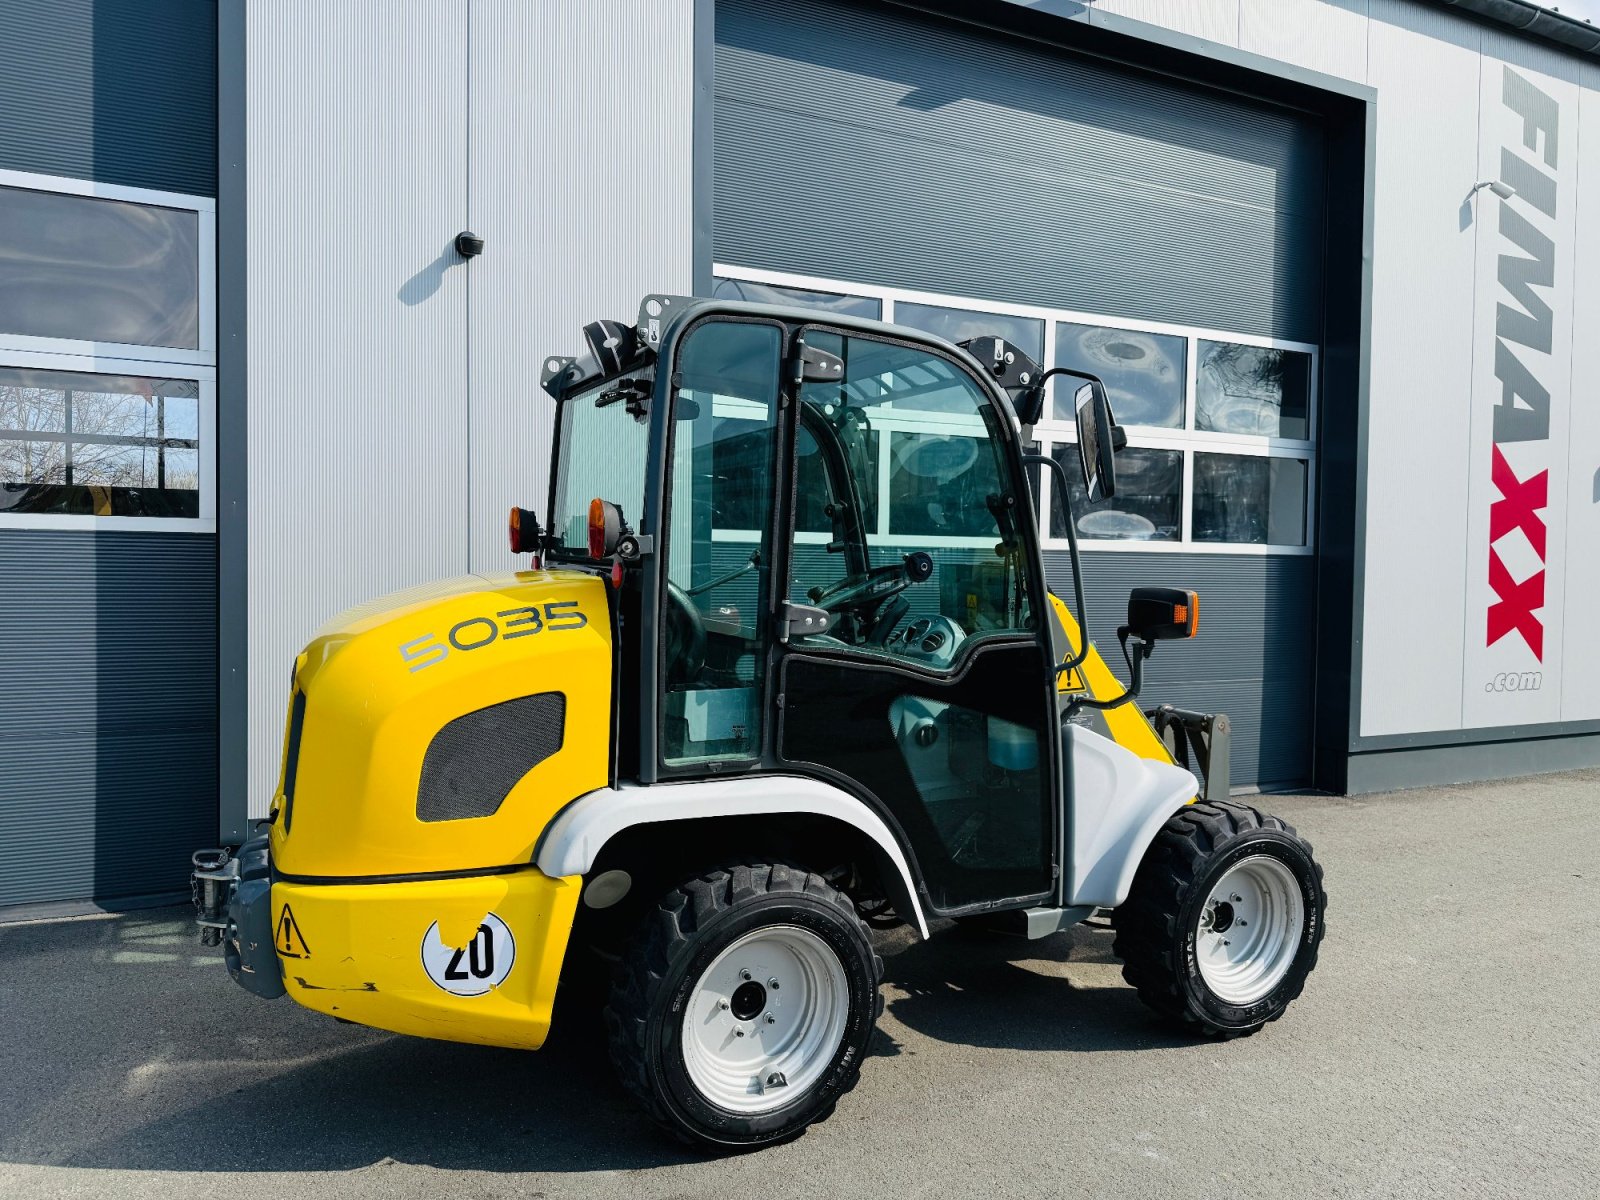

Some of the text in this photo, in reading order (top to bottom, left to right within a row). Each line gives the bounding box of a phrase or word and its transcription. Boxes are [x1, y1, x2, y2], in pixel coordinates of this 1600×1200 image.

[1486, 63, 1559, 664] FIMAXX
[399, 600, 588, 673] 5035
[1485, 671, 1542, 692] .com
